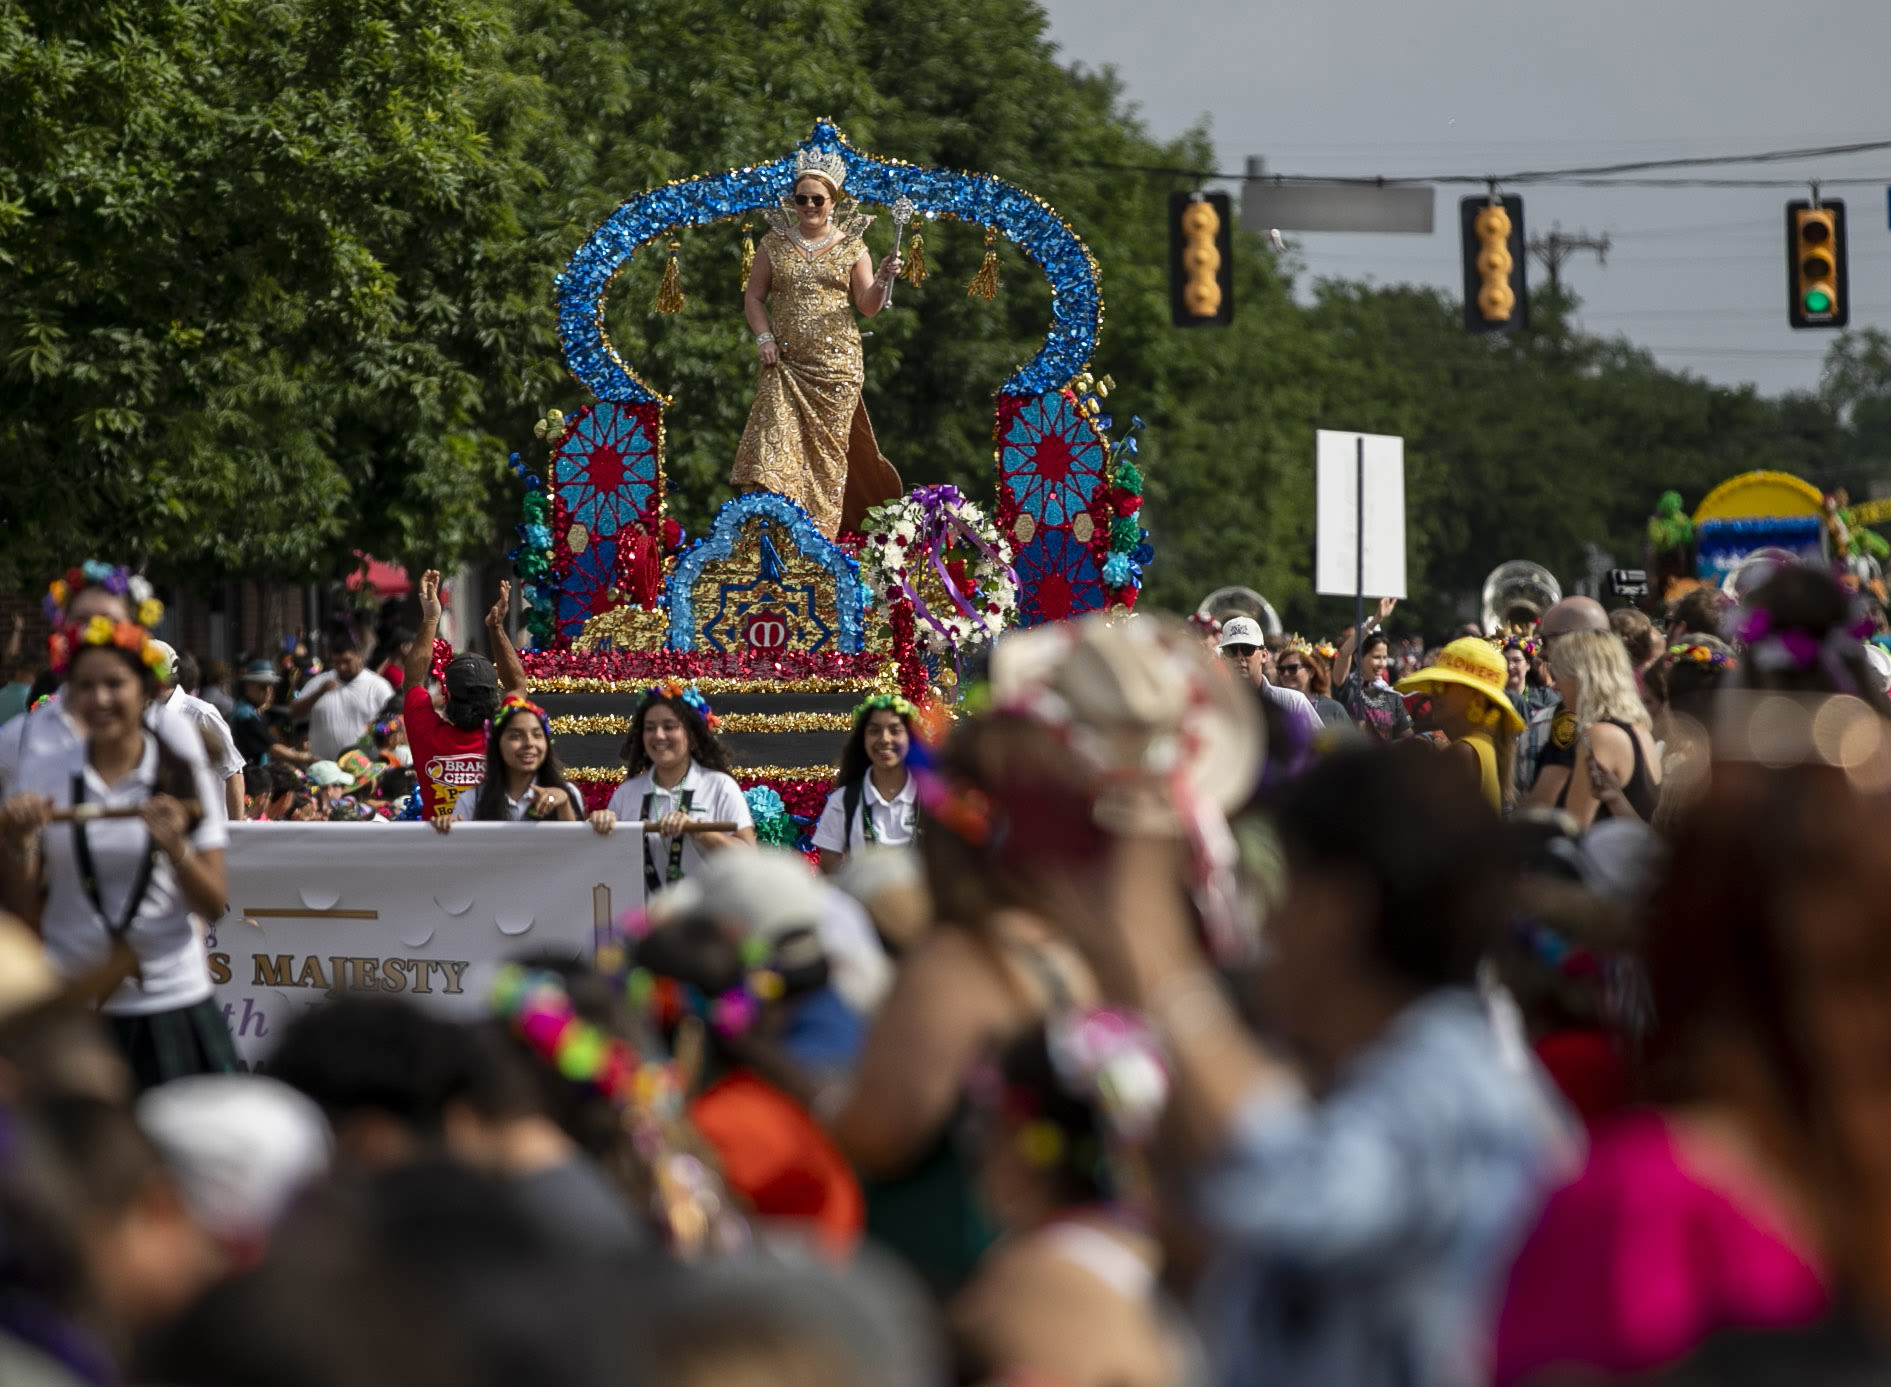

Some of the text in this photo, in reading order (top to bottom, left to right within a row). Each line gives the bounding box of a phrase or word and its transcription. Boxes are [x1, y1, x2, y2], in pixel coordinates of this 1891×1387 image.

[444, 772, 485, 784] CHEC
[445, 761, 487, 772] BRAK
[252, 953, 469, 998] MAJESTY
[221, 998, 269, 1038] th
